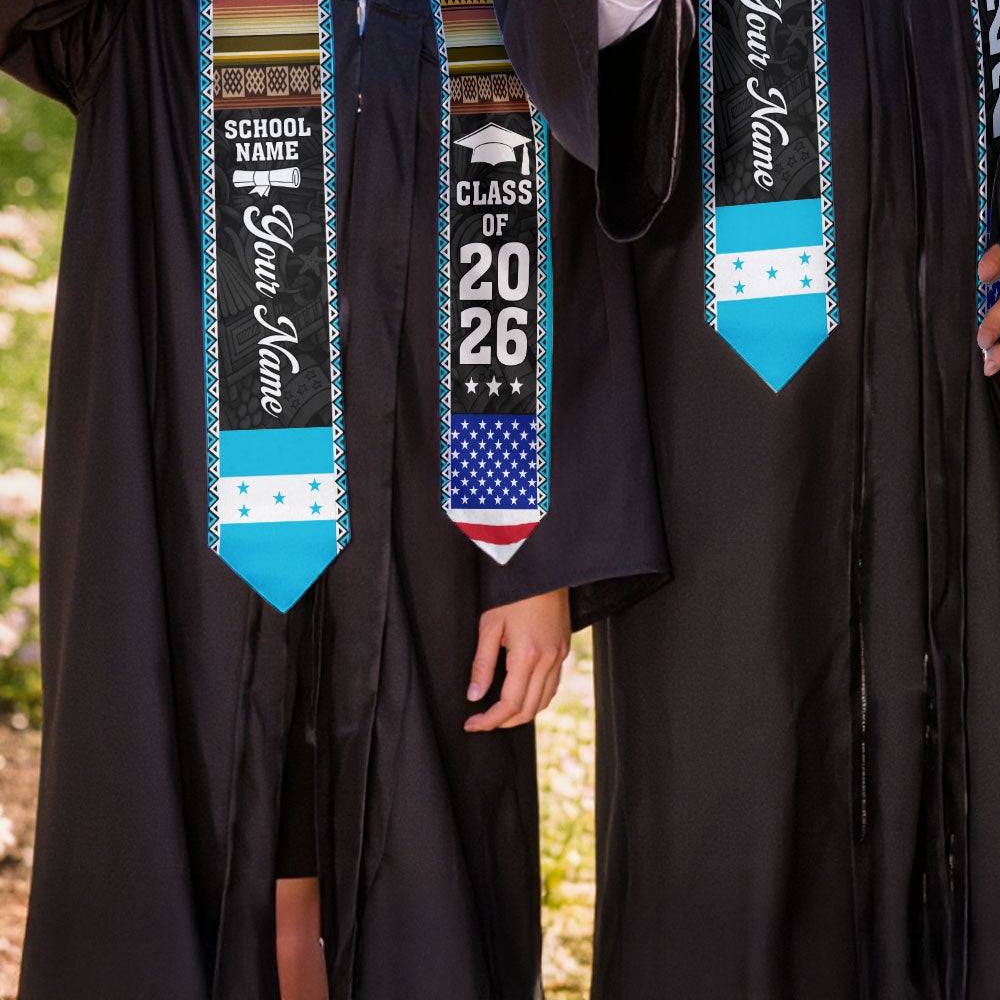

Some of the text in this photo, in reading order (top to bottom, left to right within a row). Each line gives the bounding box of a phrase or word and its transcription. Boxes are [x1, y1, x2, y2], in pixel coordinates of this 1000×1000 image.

[224, 117, 311, 139] SCHOOL
[746, 76, 790, 192] Name
[236, 140, 299, 162] NAME
[456, 179, 533, 206] CLASS
[482, 213, 509, 237] OF
[459, 242, 530, 301] 20
[243, 204, 300, 419] Your Name
[459, 306, 529, 366] 26
